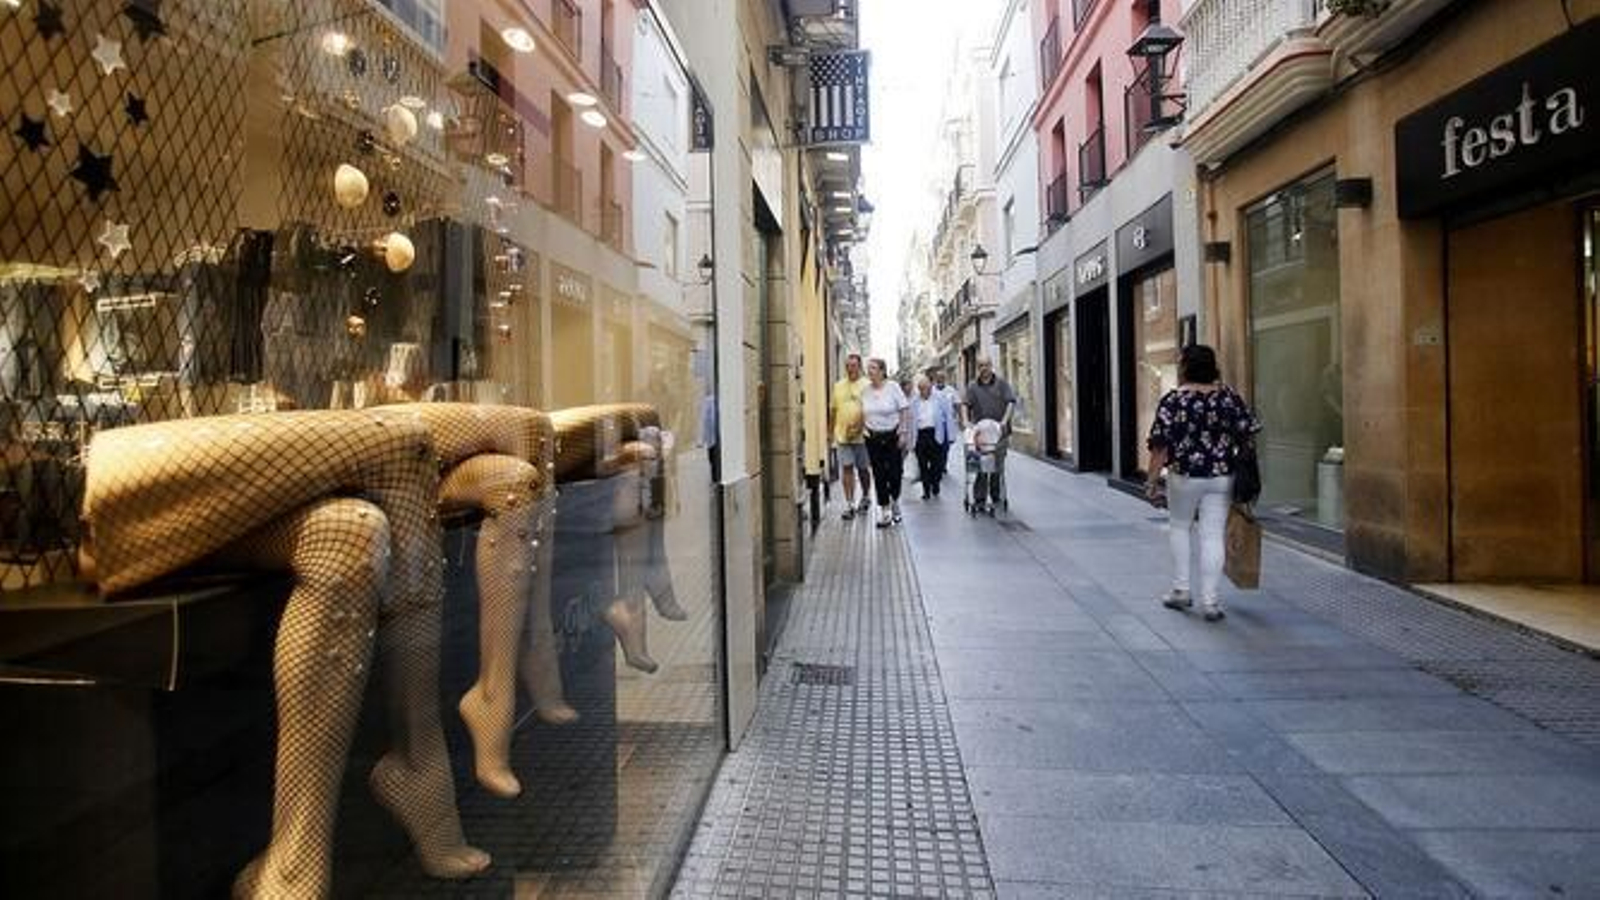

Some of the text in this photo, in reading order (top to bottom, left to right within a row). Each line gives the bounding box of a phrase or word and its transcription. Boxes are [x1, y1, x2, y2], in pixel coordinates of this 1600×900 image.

[855, 55, 866, 127] VINTAGE
[814, 128, 865, 139] SHOP
[1440, 81, 1584, 179] festa
